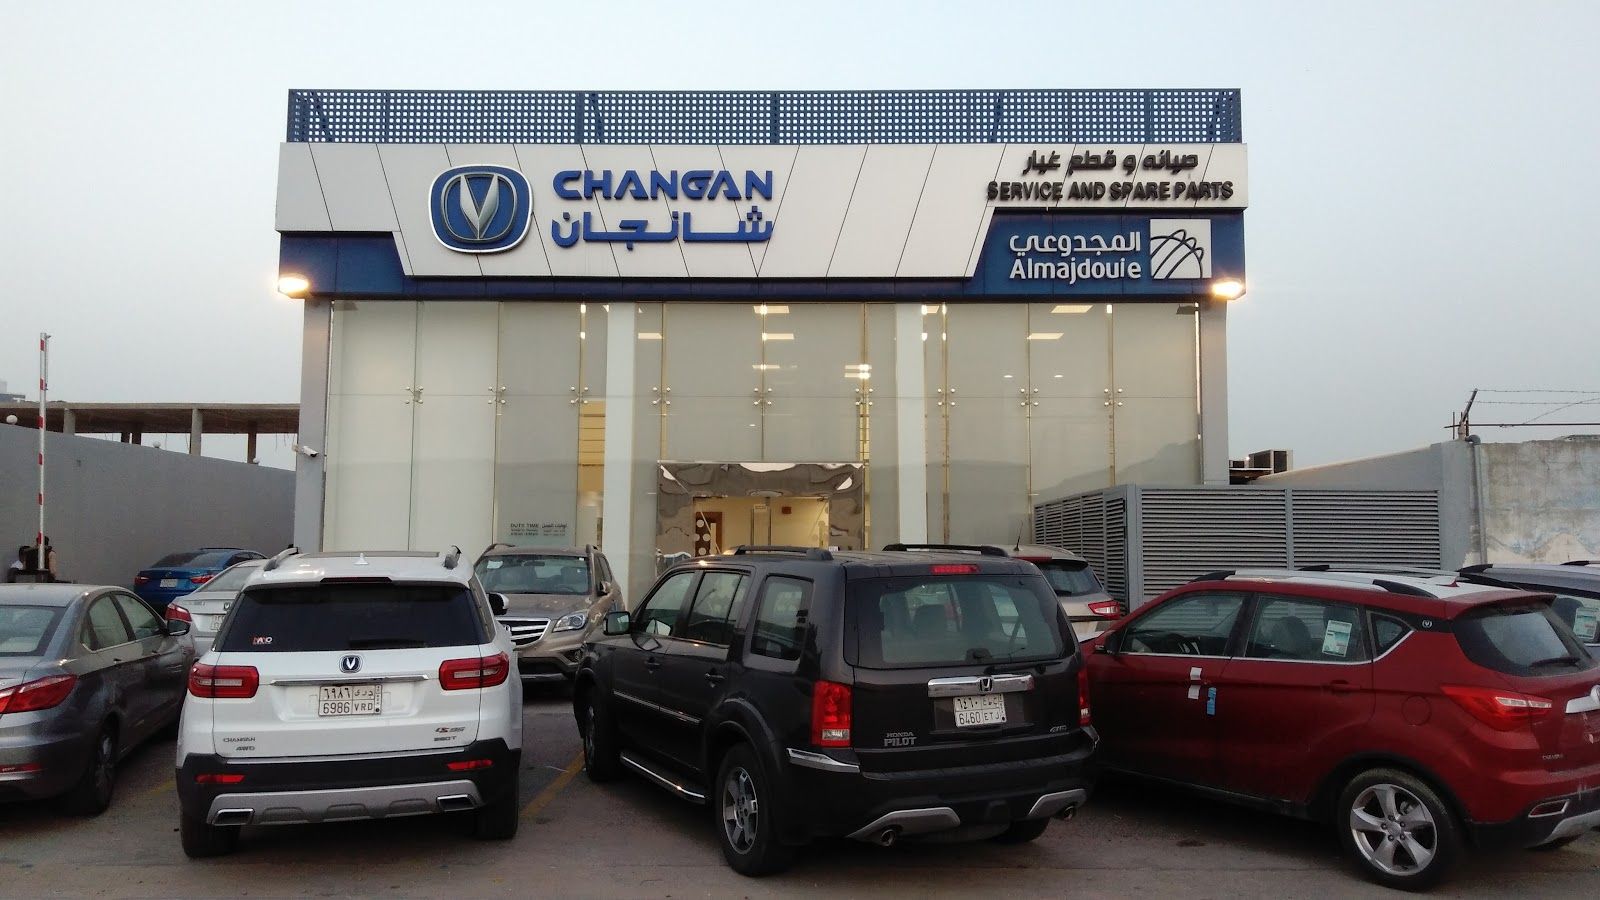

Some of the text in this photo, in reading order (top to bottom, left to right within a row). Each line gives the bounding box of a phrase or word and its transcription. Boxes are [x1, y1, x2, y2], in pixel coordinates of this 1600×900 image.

[1021, 150, 1061, 176] غيار
[1067, 150, 1117, 177] قطع
[1122, 154, 1137, 176] و
[552, 170, 773, 200] CHANGAN
[987, 180, 1234, 201] SERVICE AND SPARE PARTS
[551, 205, 773, 250] شانجان
[1009, 231, 1141, 256] المجدوعي
[1009, 258, 1142, 284] Almajdouie
[323, 702, 373, 714] 6986 VRD
[959, 711, 981, 725] 6460
[884, 736, 917, 746] PILOT
